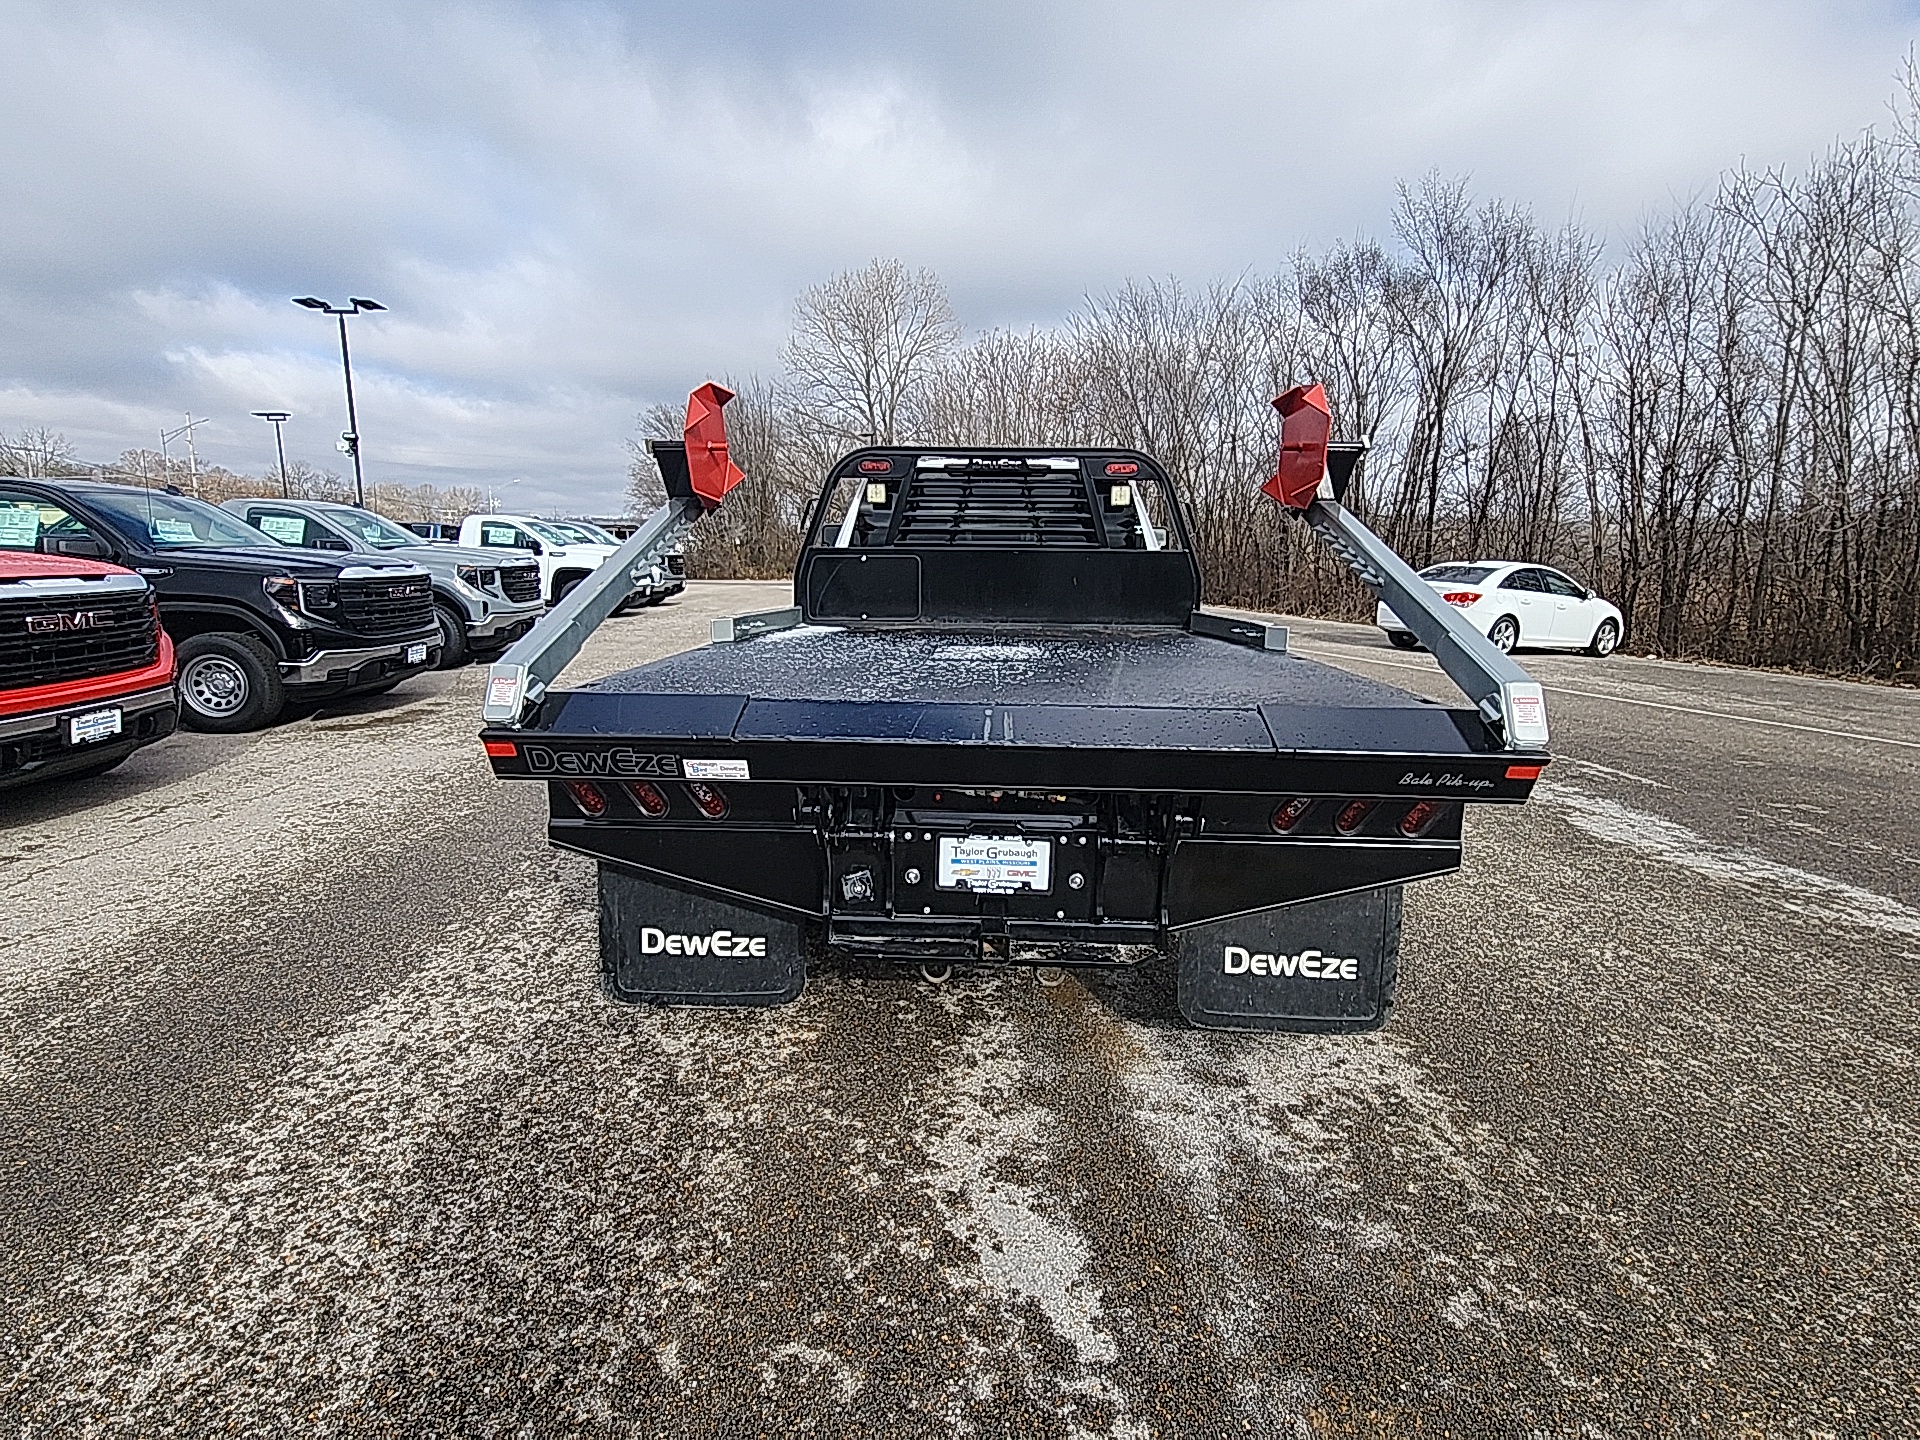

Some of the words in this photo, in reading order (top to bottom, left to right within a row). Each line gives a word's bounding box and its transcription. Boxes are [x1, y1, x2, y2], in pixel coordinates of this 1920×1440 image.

[26, 609, 114, 634] GMC
[523, 745, 679, 775] DewEze
[951, 845, 984, 858] Taylor
[986, 846, 1038, 859] Grubaugh
[1006, 869, 1038, 878] GMC
[641, 927, 767, 957] DewEze
[1224, 946, 1358, 980] DewEze
